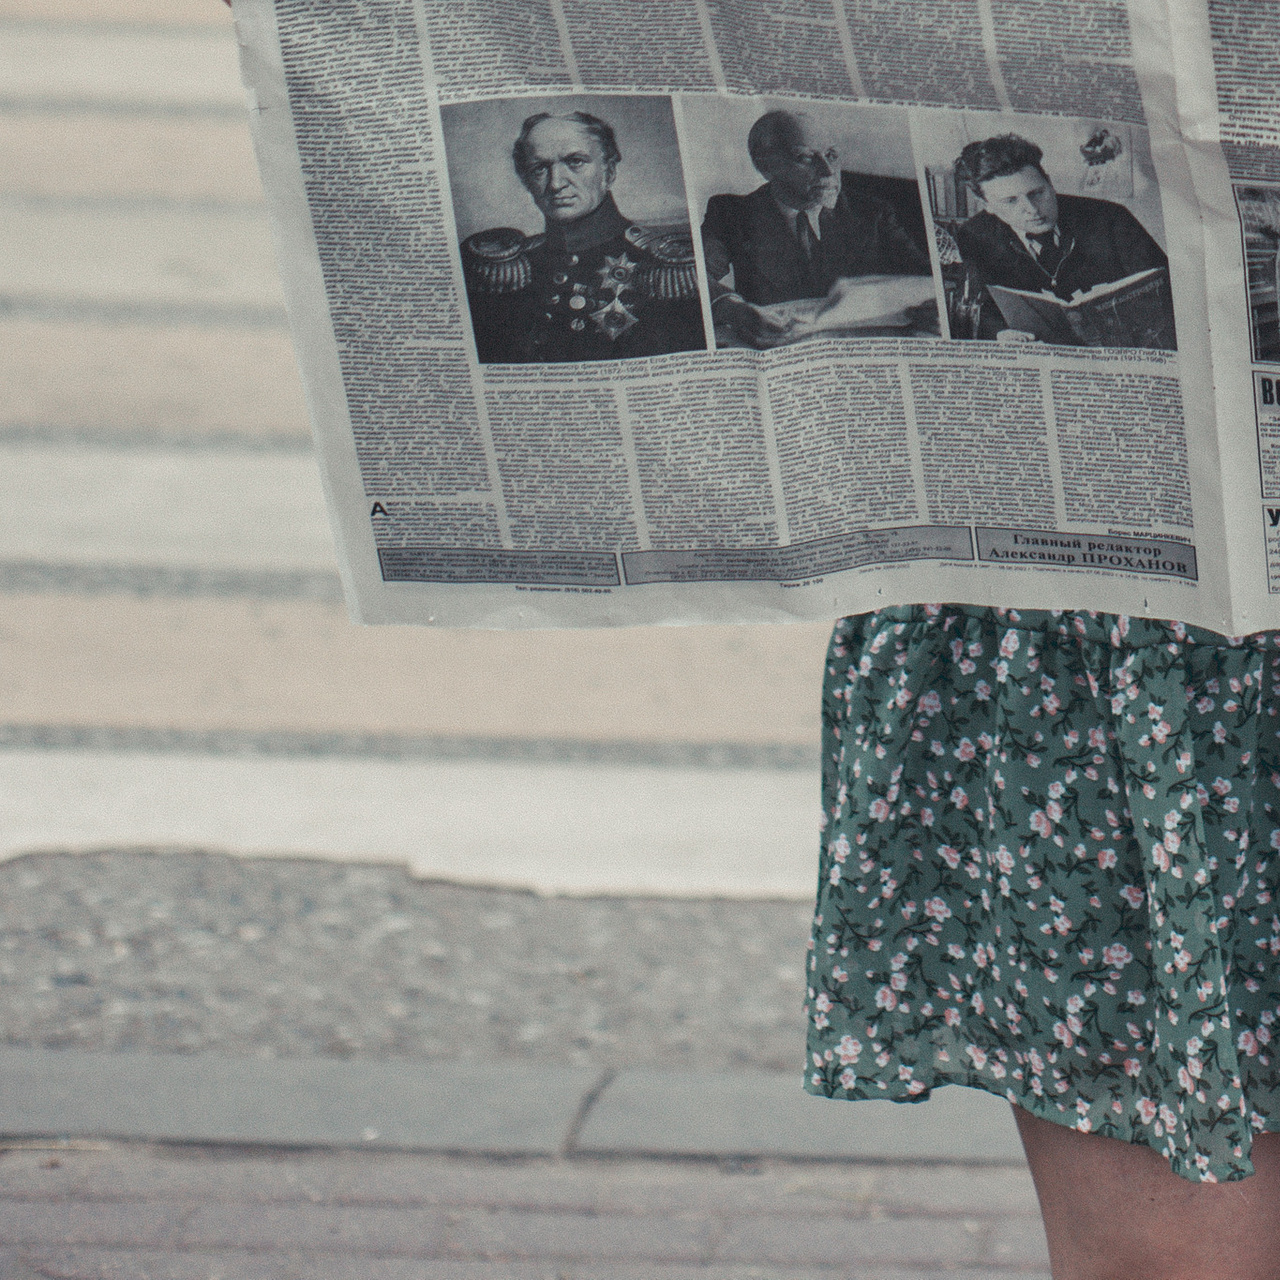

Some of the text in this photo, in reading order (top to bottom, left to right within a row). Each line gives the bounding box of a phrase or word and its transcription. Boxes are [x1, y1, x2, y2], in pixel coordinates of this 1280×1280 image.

[1014, 533, 1162, 557] Главный редактор
[988, 546, 1188, 574] Александр ПРОХАНОВ
